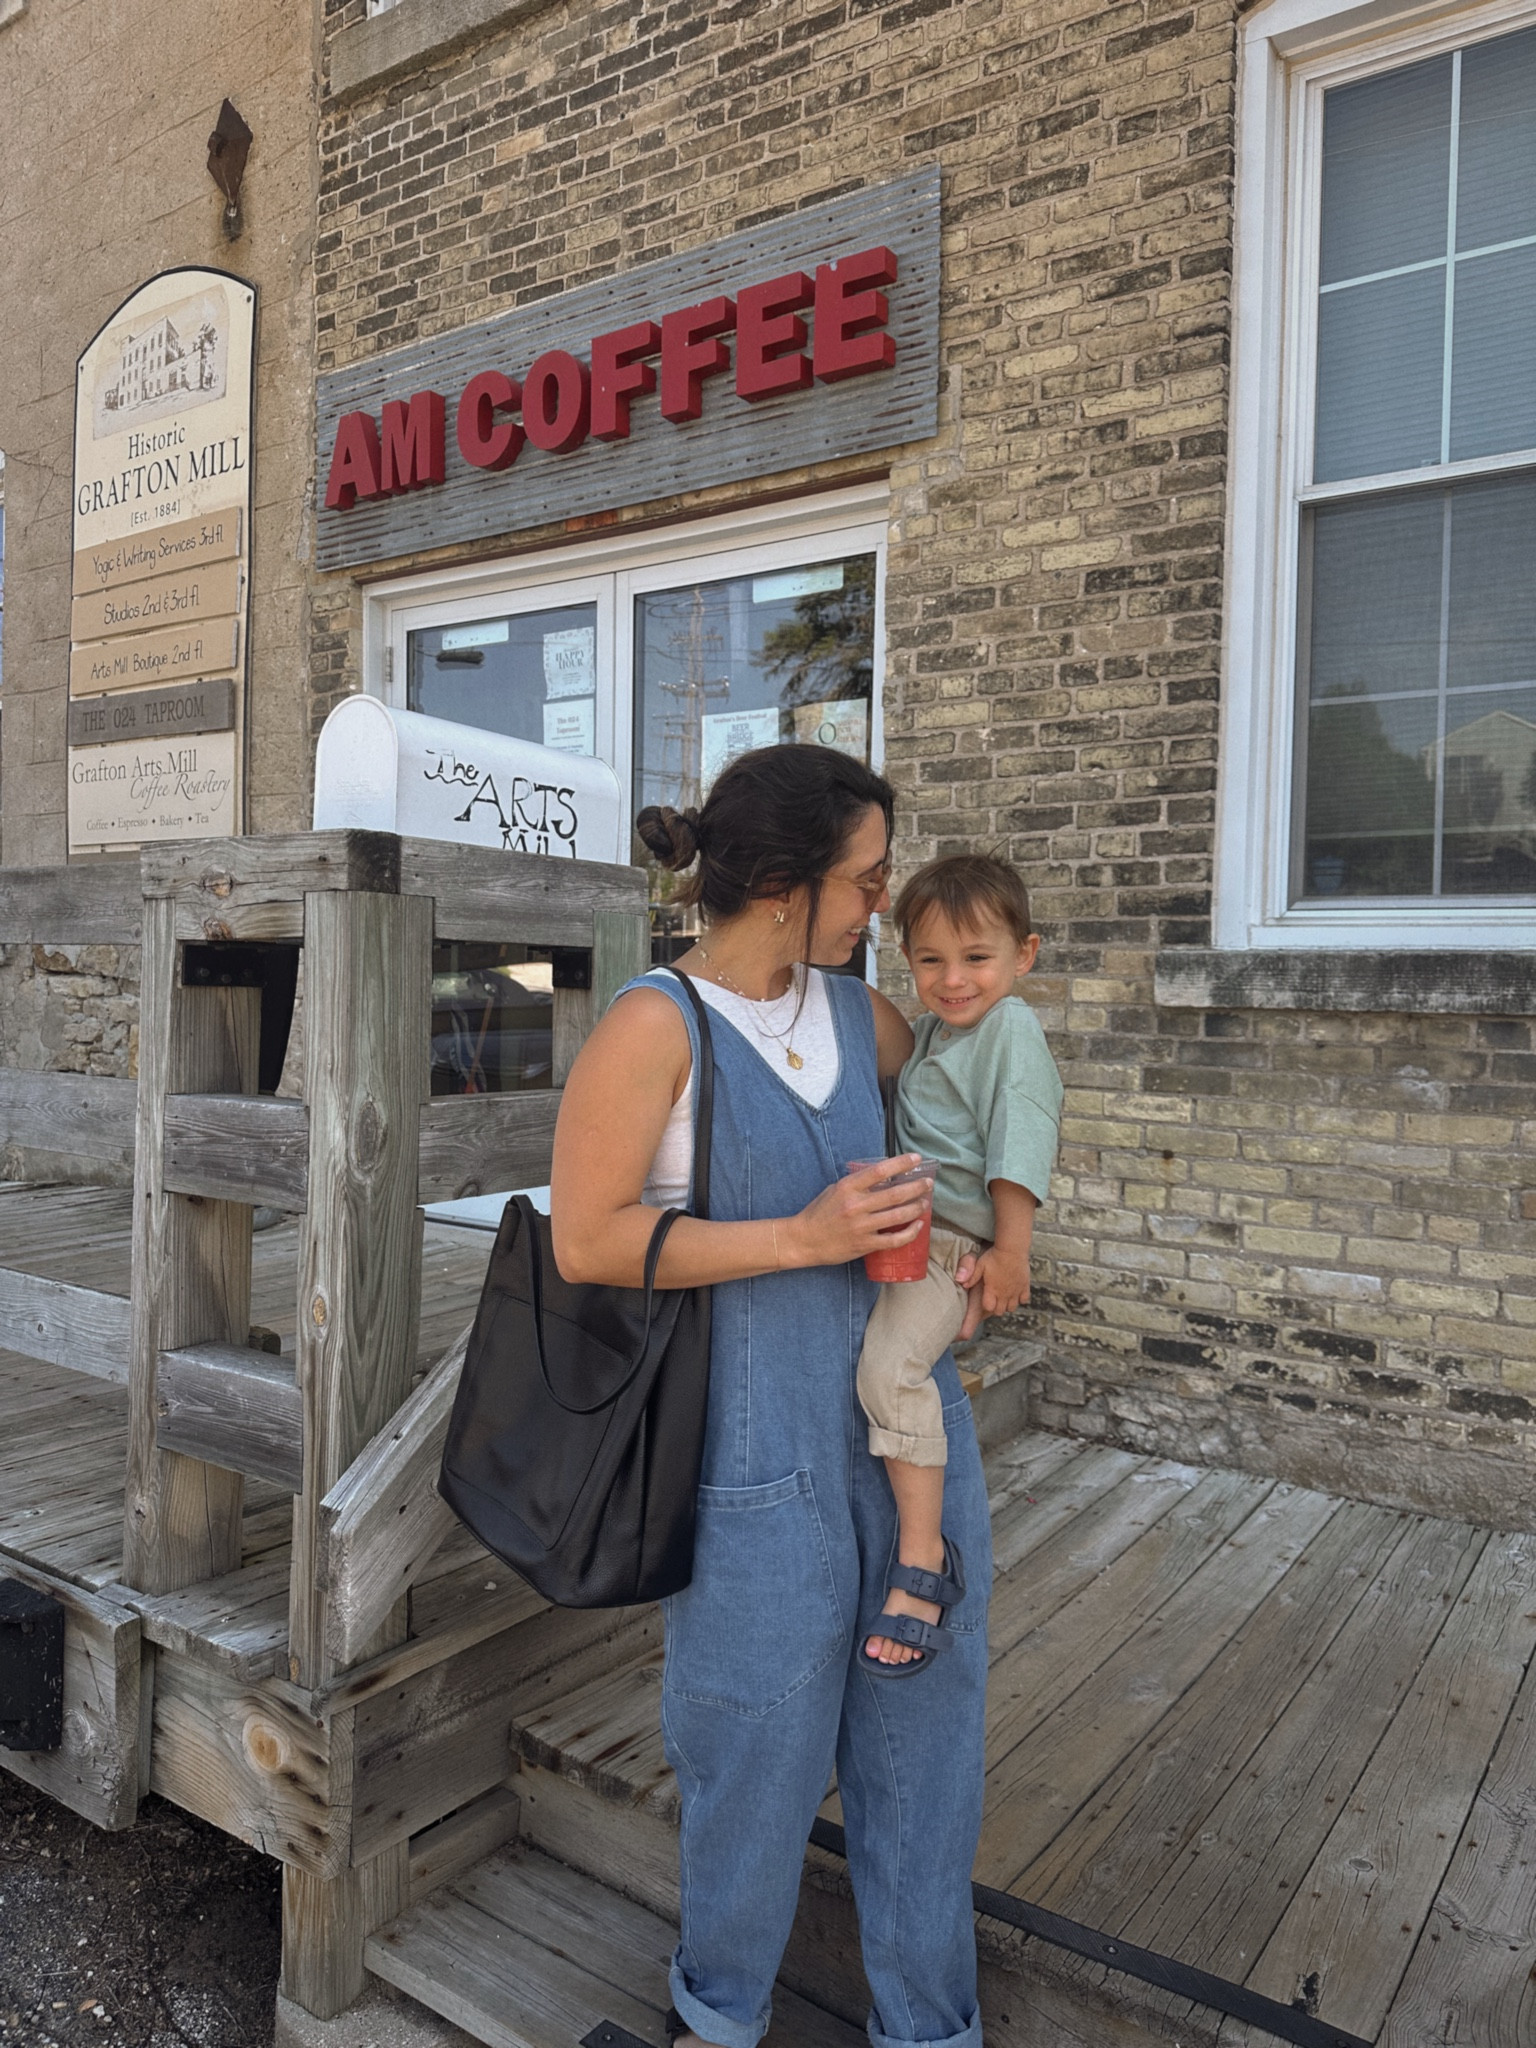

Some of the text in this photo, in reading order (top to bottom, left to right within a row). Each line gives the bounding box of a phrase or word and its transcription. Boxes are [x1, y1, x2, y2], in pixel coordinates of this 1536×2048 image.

[325, 246, 898, 511] AM COFFEE
[128, 422, 186, 460] Historic
[78, 437, 246, 516] GRAFTON MILL
[92, 556, 115, 583] Yogic
[123, 547, 156, 570] Writing
[158, 537, 196, 558] Services
[199, 526, 215, 546] 3rd
[215, 524, 224, 544] fl
[104, 600, 140, 625] Studios
[142, 595, 161, 617] 2nd
[170, 587, 187, 611] 3rd
[188, 584, 200, 606] fl
[91, 640, 203, 681] Arts Mill Boutique 2nd fl
[83, 696, 205, 732] THE 024 TAPROOM
[72, 749, 198, 784] Grafton Arts Mill
[425, 749, 479, 782] The
[130, 769, 231, 814] Coffee Roastery
[454, 774, 578, 840] ARTS
[86, 812, 209, 832] Coffee Espresso Bakery Tea
